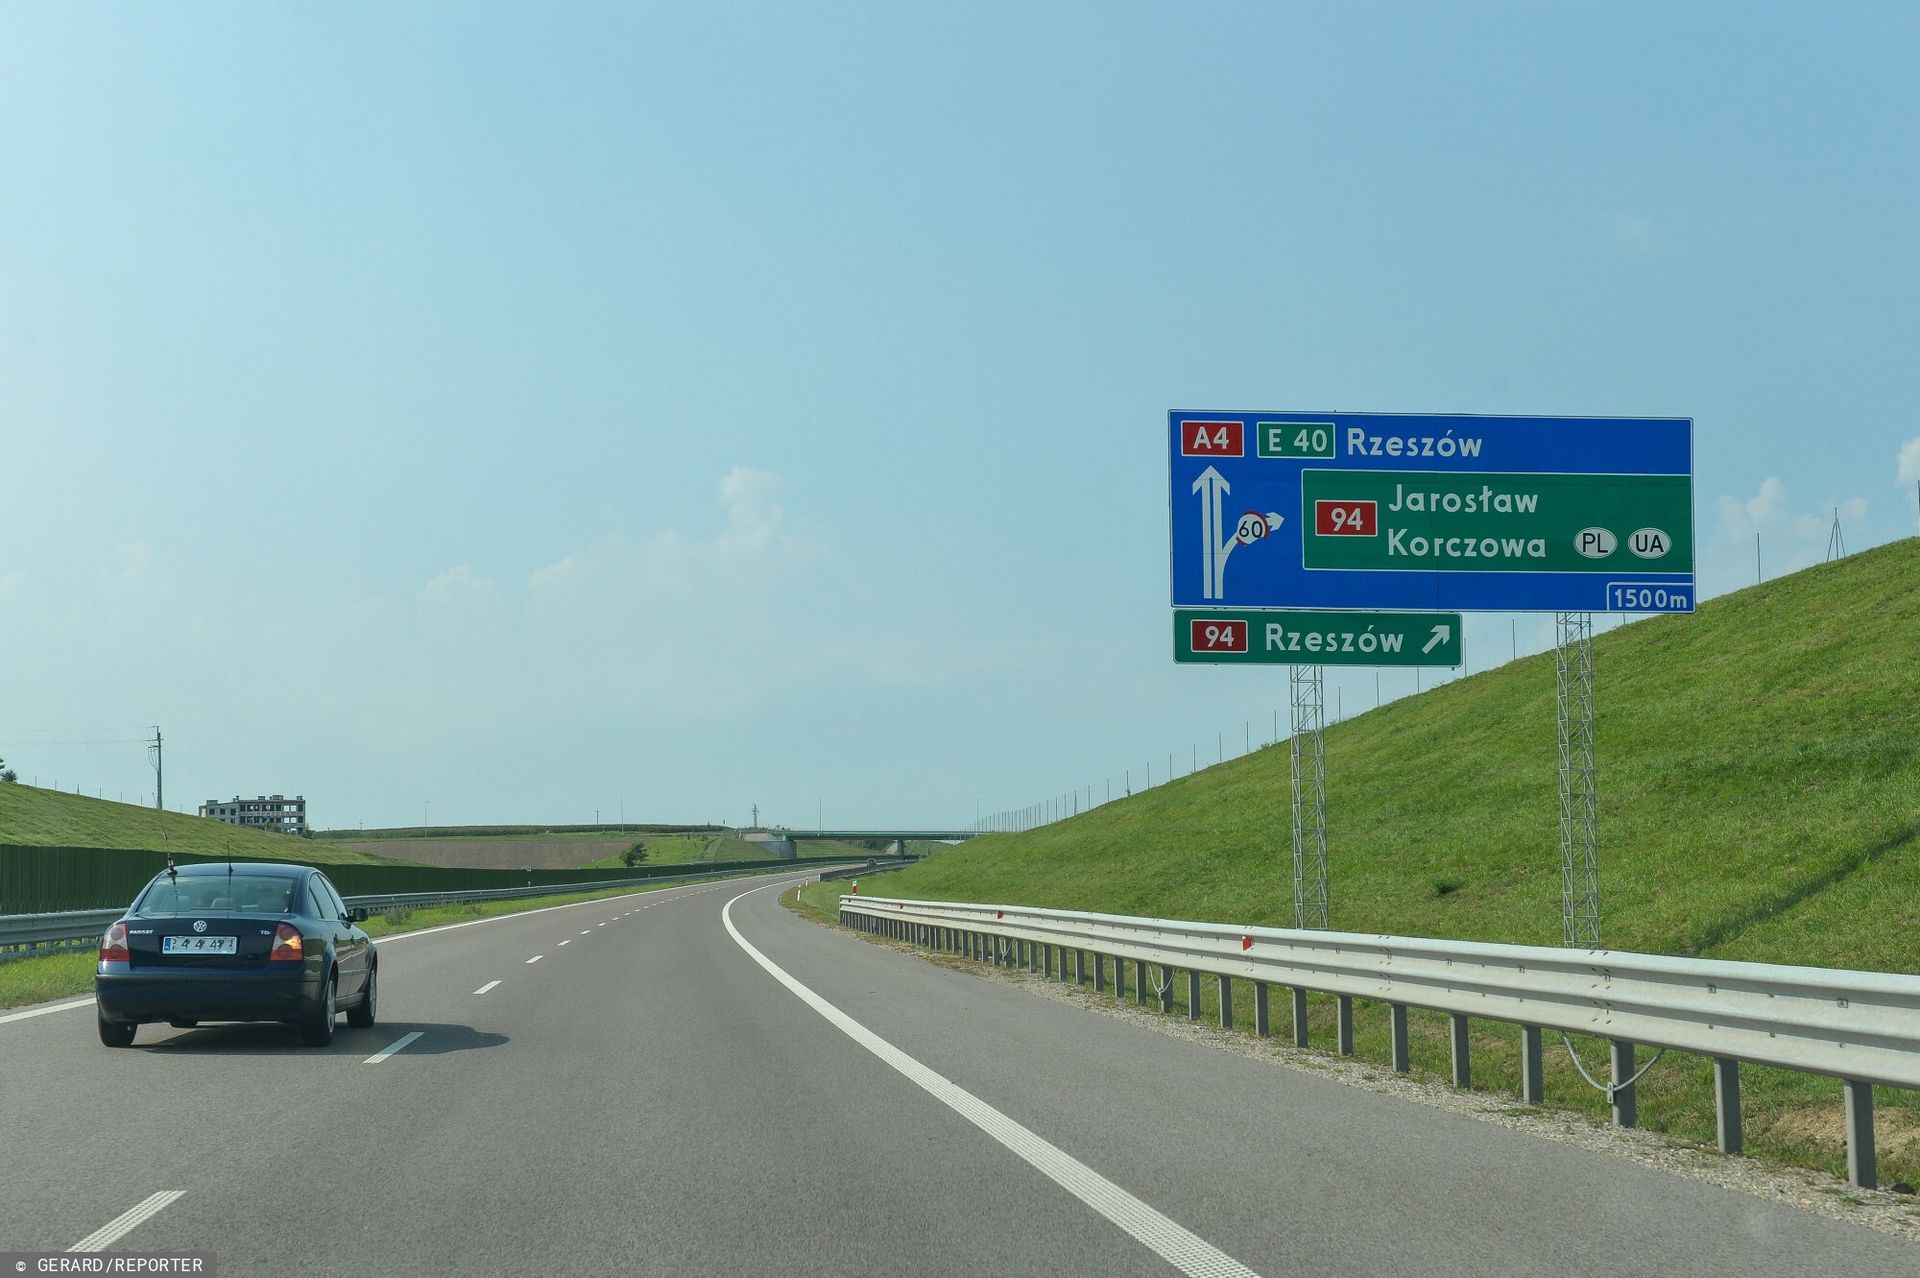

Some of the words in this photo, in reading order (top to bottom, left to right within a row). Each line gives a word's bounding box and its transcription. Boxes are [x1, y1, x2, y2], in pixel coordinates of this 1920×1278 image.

[1193, 426, 1230, 450] A4
[1268, 428, 1282, 452] E
[1293, 428, 1328, 453] 40
[1347, 427, 1483, 457] Rzeszów
[1388, 484, 1539, 513] Jarosław
[1239, 520, 1263, 538] 60
[1330, 507, 1363, 532] 94
[1388, 528, 1547, 558] Korczowa
[1582, 532, 1609, 553] PL
[1635, 534, 1665, 553] UA
[1614, 588, 1688, 609] 1500m
[1204, 625, 1234, 648] 94
[1265, 623, 1404, 653] Rzeszów
